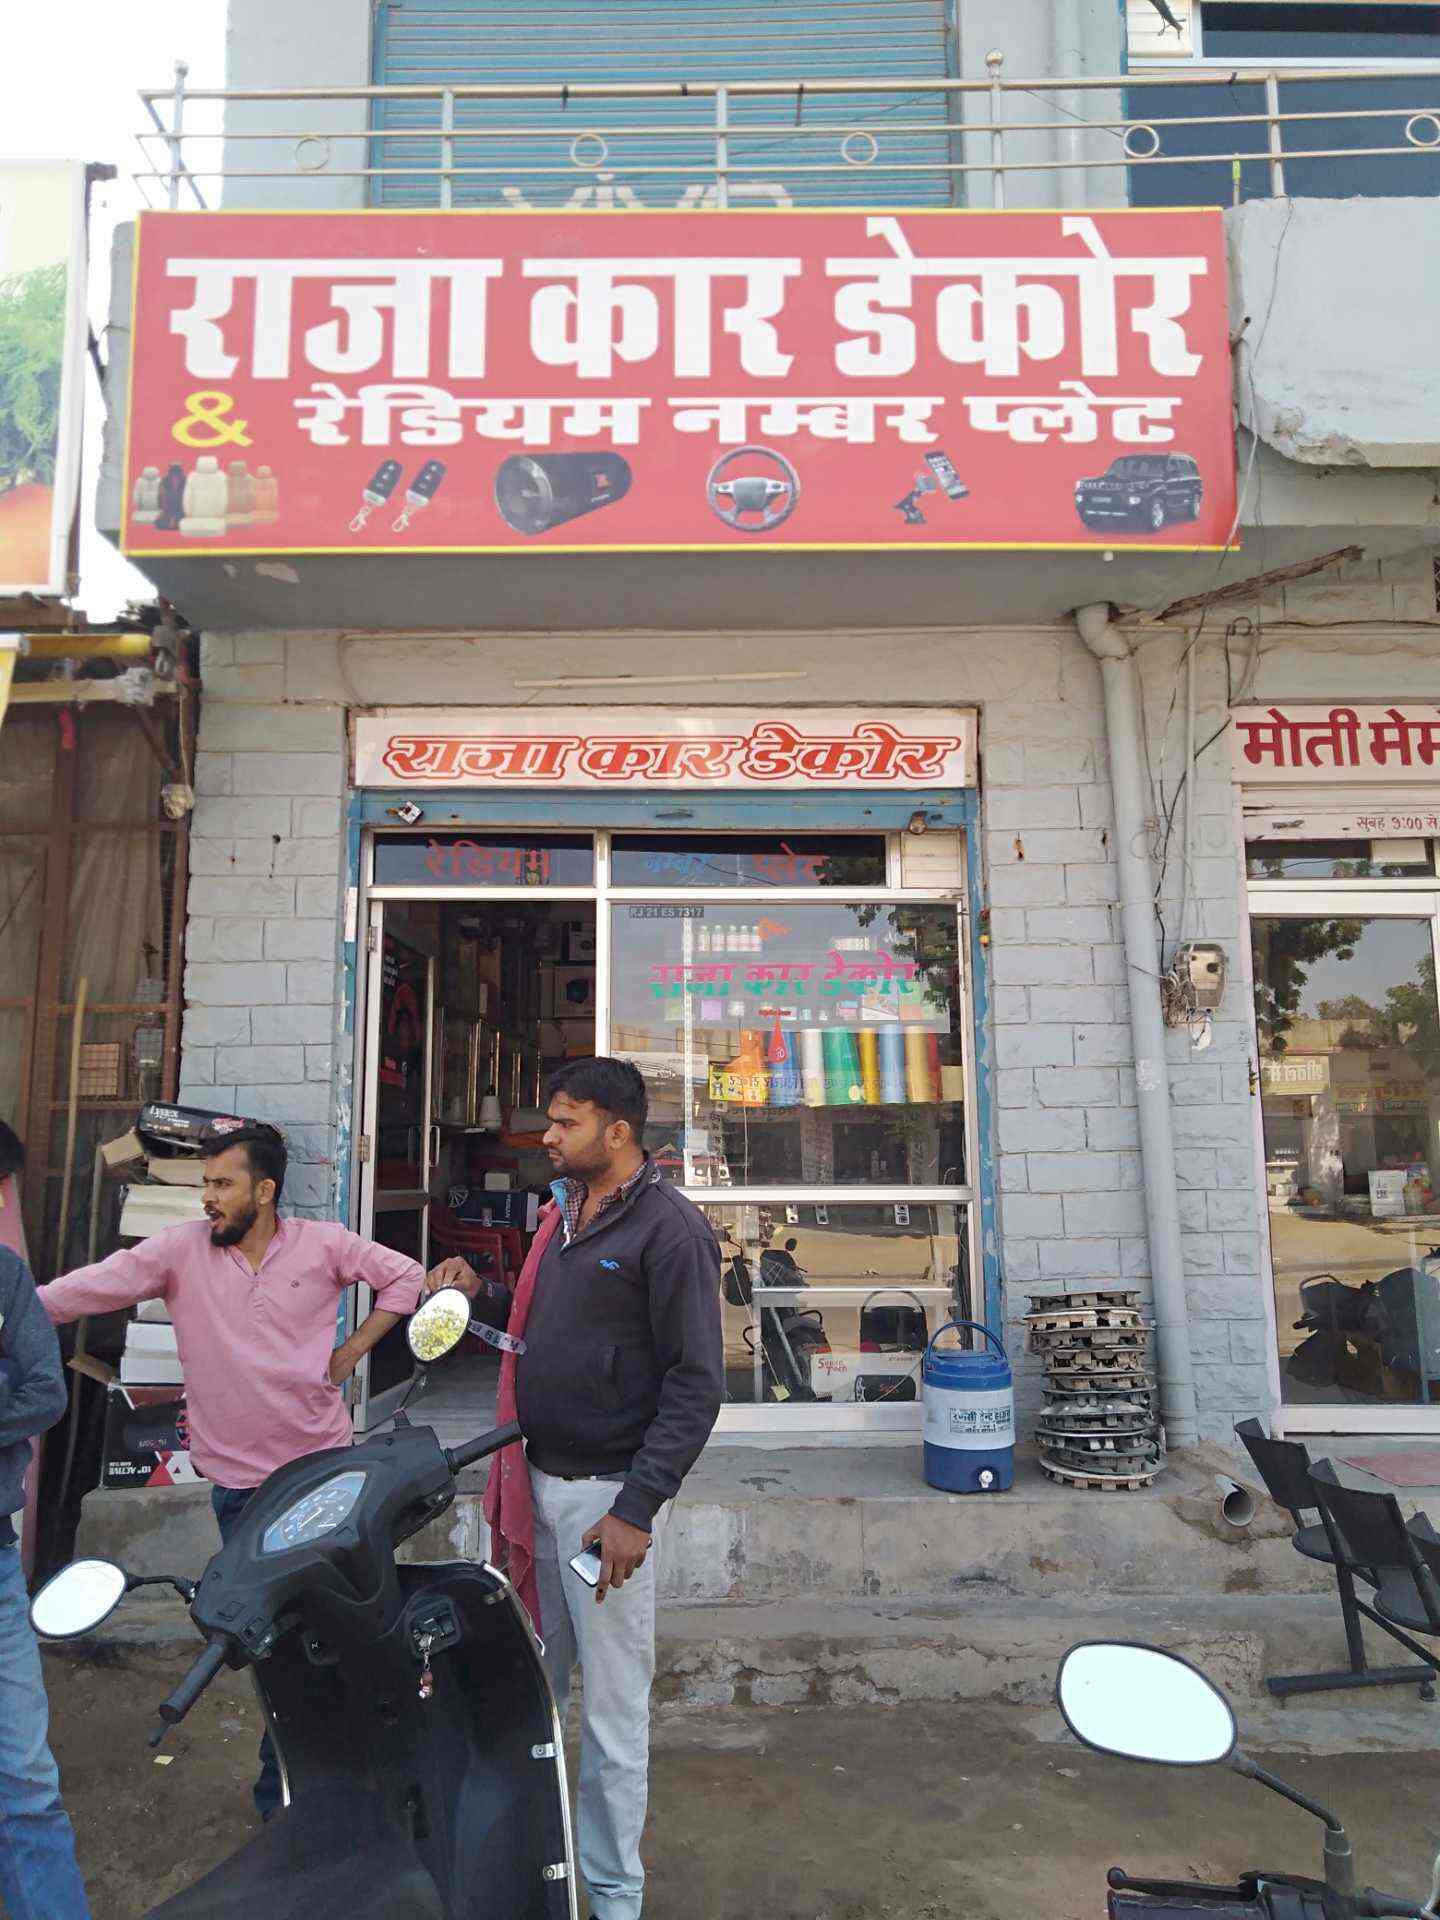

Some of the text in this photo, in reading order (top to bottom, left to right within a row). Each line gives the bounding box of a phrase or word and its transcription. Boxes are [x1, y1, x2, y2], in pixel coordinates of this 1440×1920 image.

[166, 216, 1208, 379] राजा कार डेकोर
[171, 381, 1182, 448] & रेडियम नम्बर प्लेट
[382, 721, 962, 780] राजा कार डेकोर
[1235, 707, 1361, 767] मोती
[651, 949, 919, 998] राजा कार डेकोर
